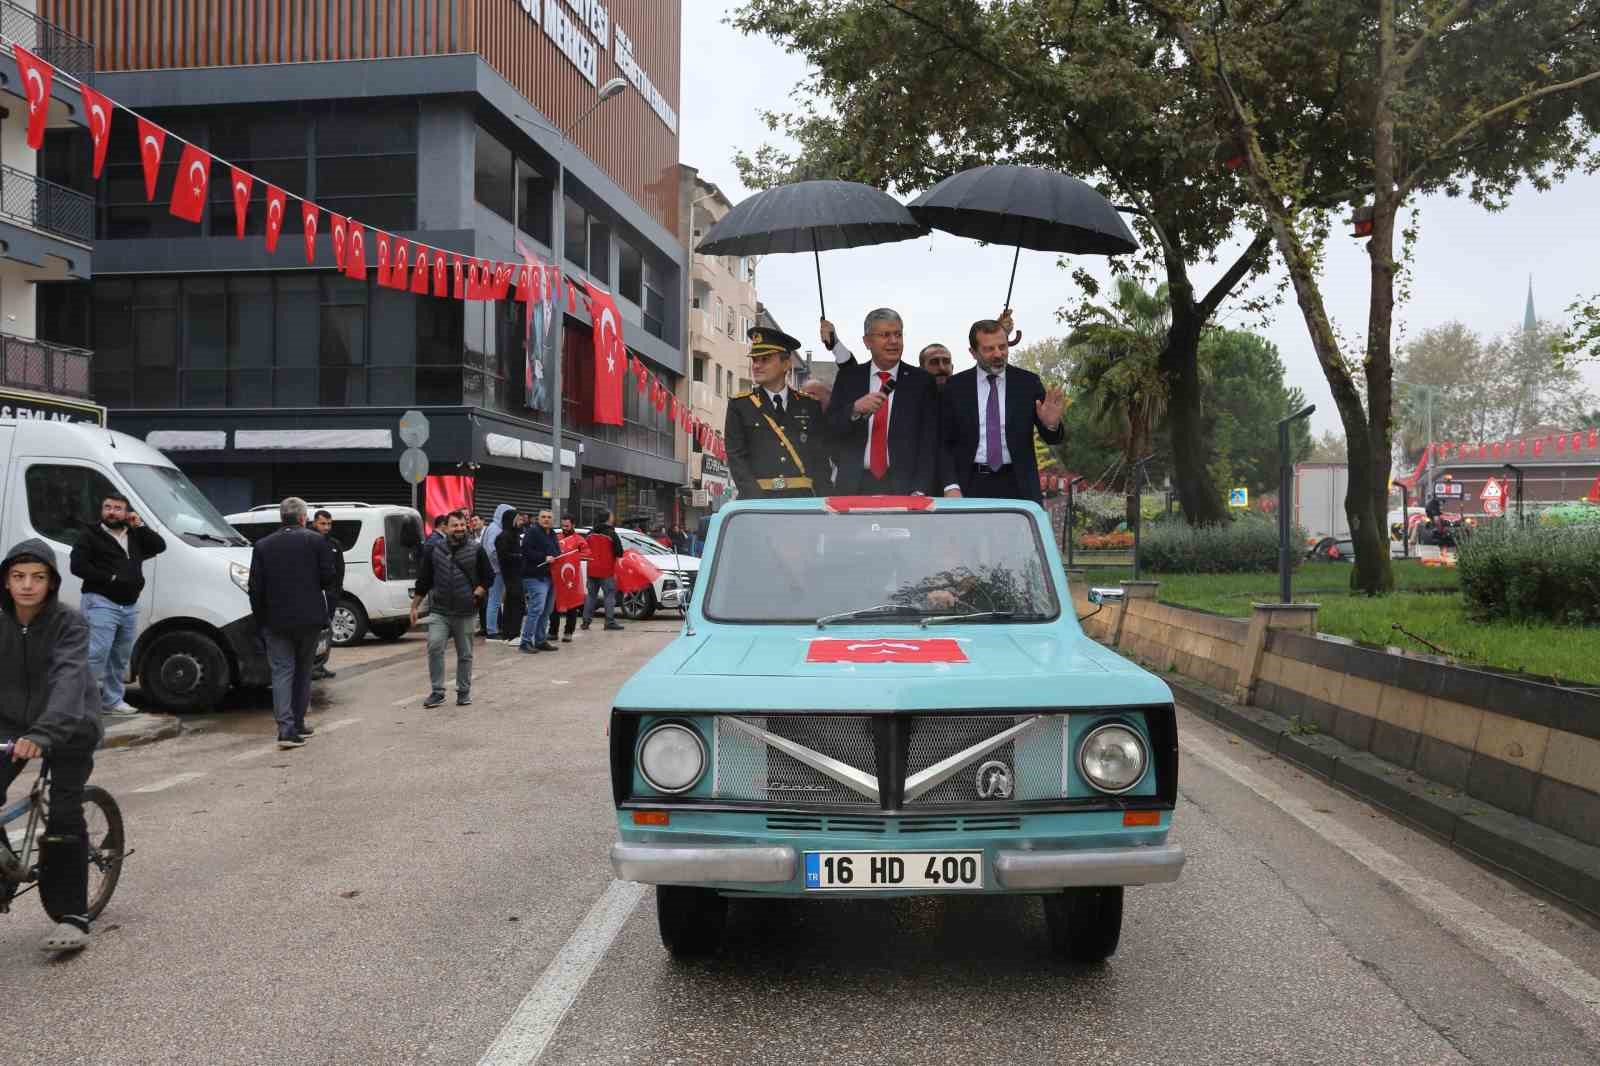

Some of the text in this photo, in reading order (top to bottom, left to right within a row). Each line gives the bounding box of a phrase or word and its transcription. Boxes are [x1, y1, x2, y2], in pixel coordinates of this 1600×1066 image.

[807, 856, 977, 884] TR 16 HD 400
